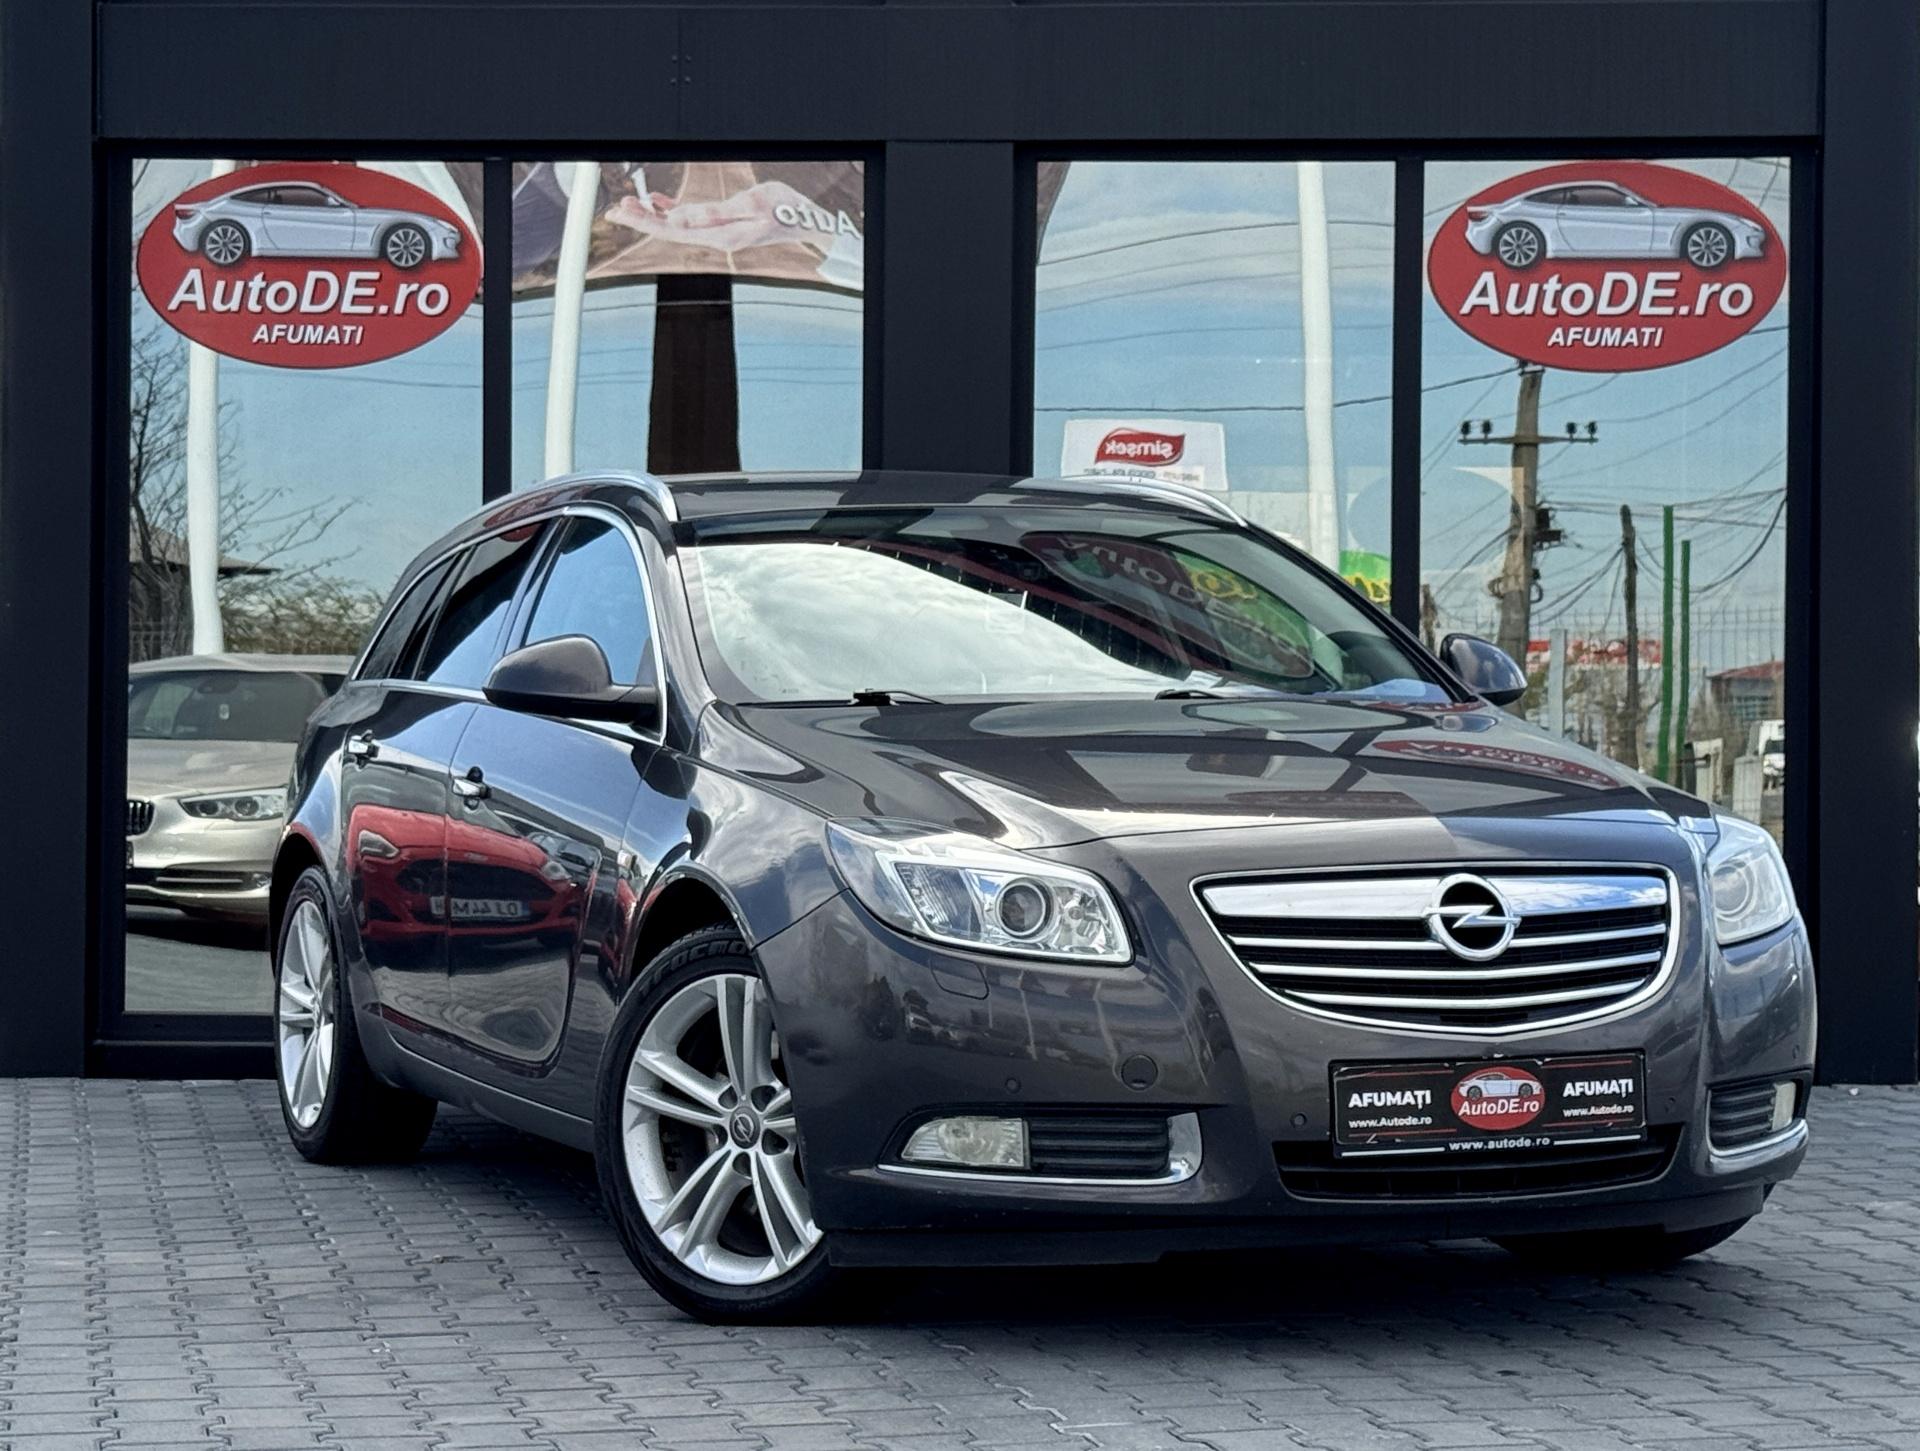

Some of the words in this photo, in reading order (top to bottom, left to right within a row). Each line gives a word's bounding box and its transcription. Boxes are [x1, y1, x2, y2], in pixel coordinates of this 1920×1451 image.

[167, 268, 450, 316] AutoDE.ro
[1460, 270, 1754, 317] AutoDE.ro
[252, 324, 364, 346] AFUMATI
[1547, 326, 1664, 348] AFUMATI
[1458, 1098, 1540, 1117] AutoDE.ro
[1348, 1116, 1433, 1129] www.Autode.ro
[1448, 1137, 1551, 1152] www.autode.ro
